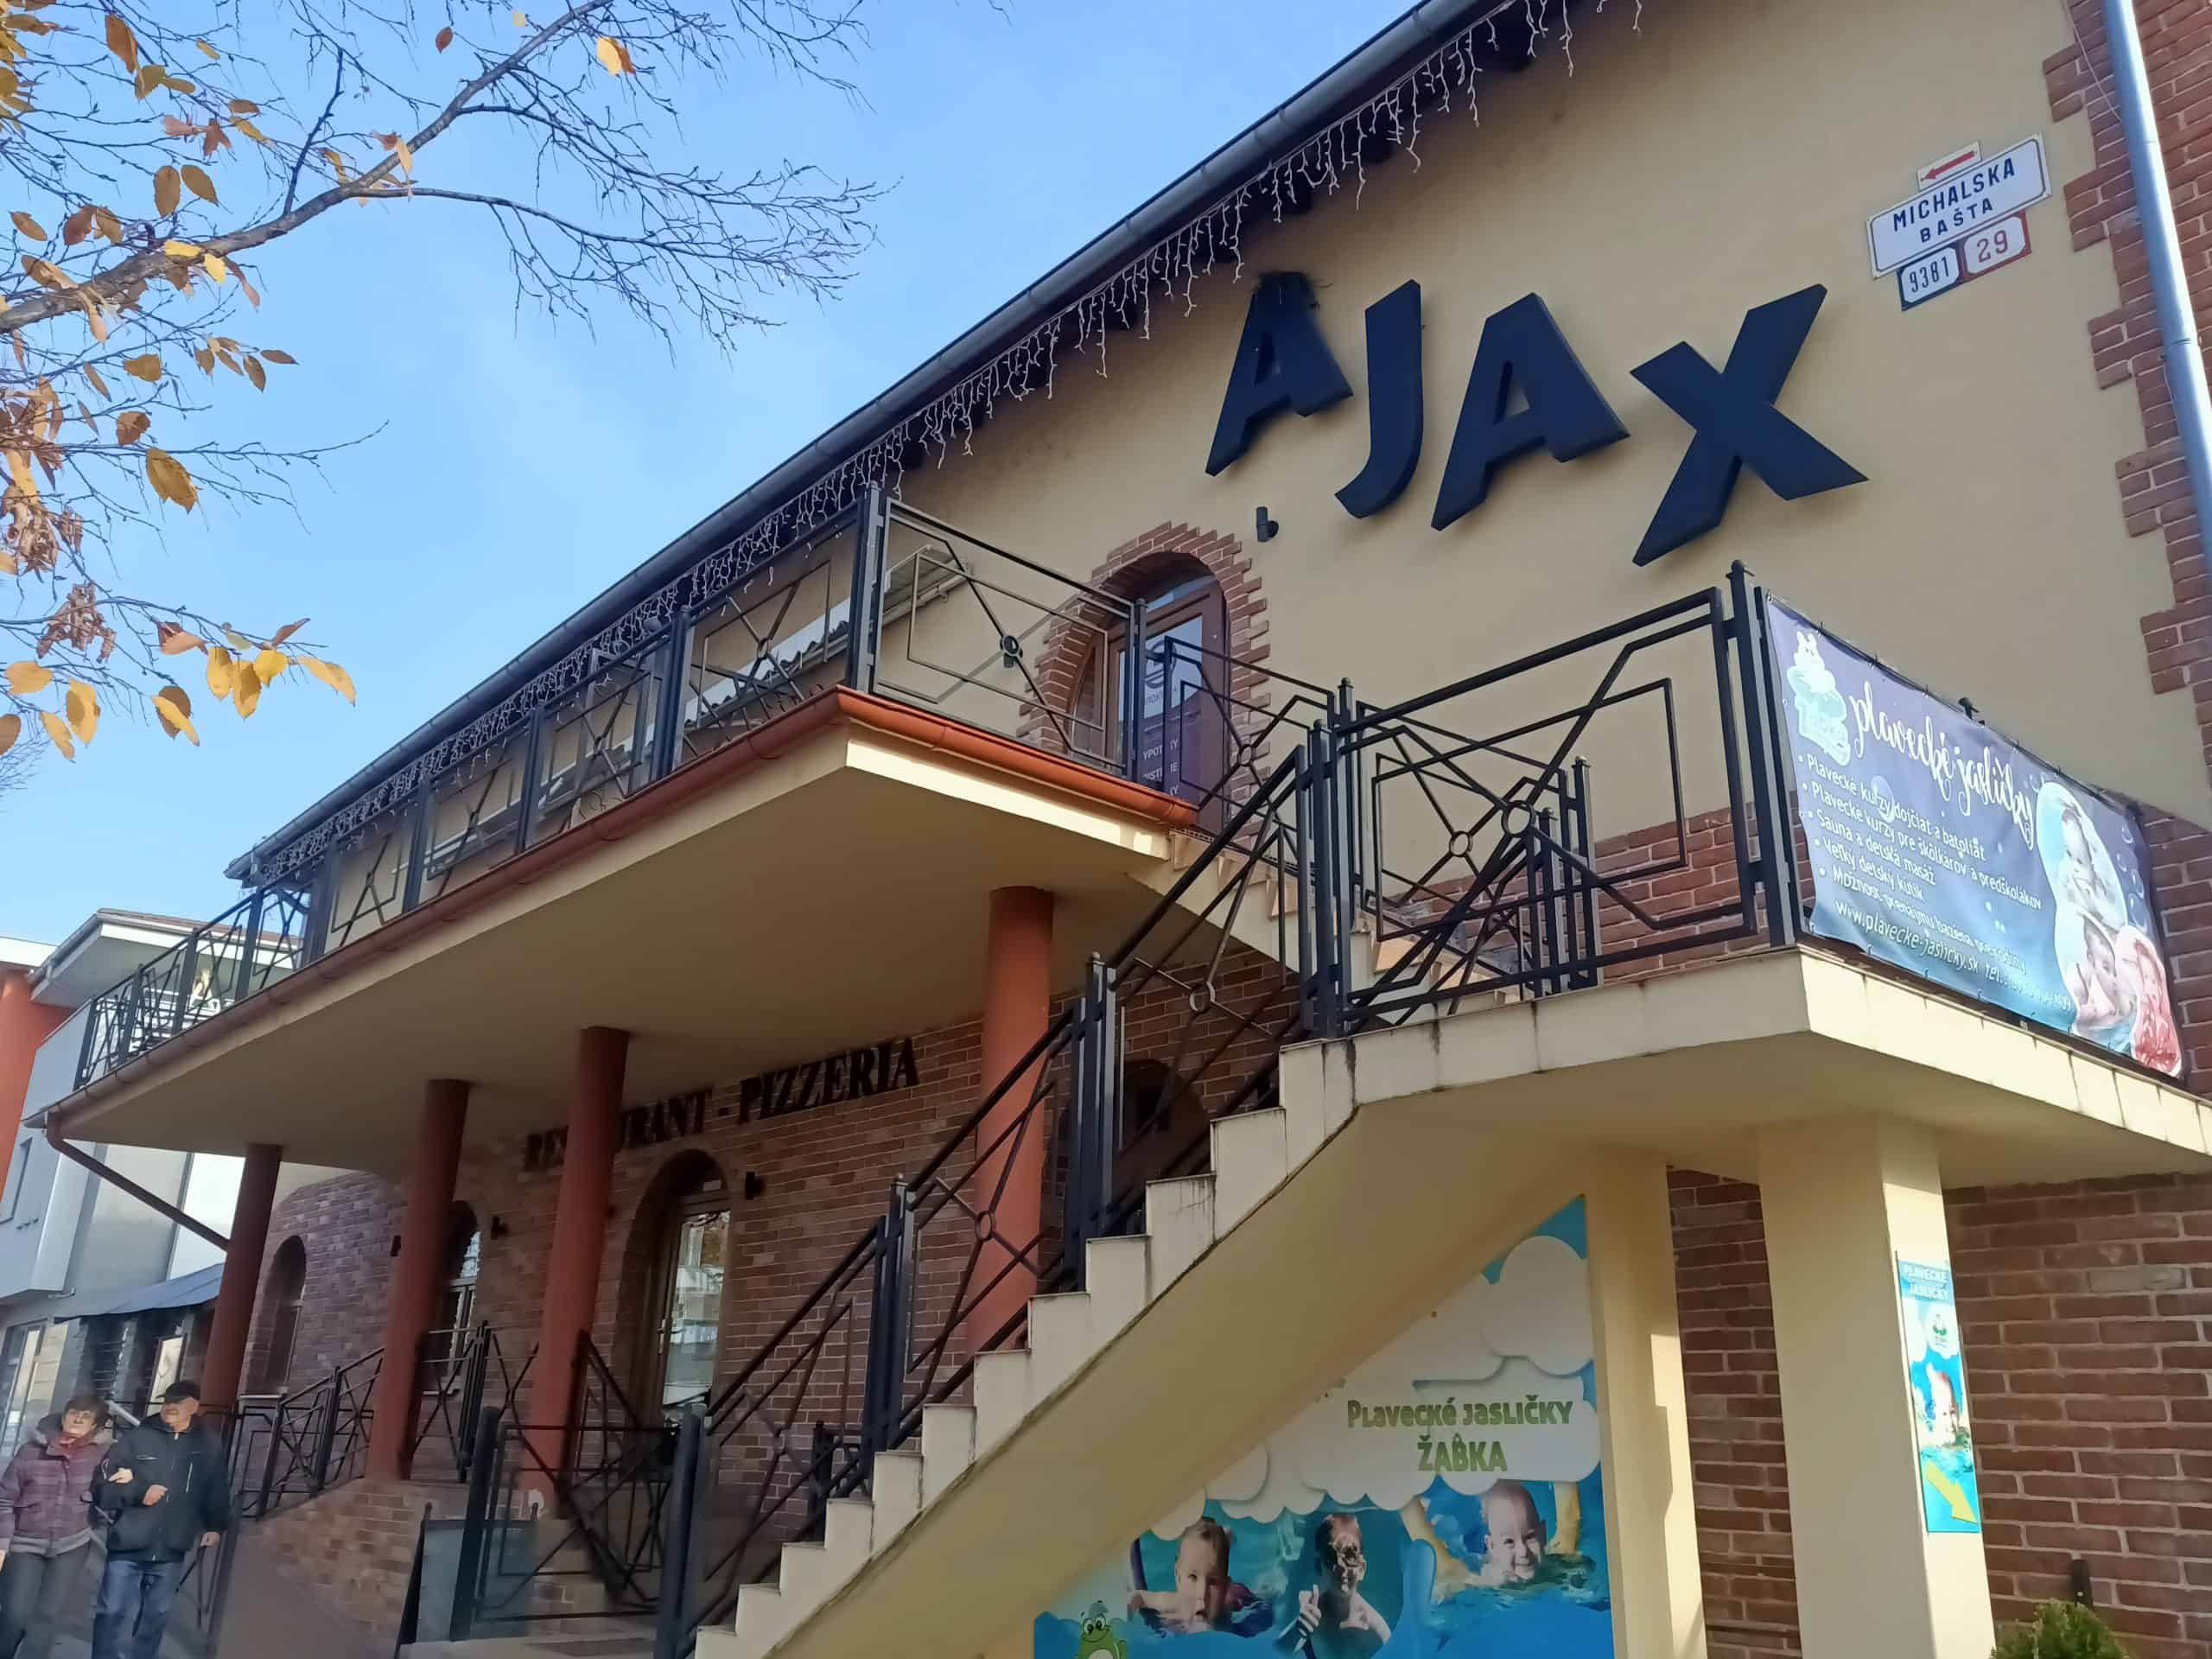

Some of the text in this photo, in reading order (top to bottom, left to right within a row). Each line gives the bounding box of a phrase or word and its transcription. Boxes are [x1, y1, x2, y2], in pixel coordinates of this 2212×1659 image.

[1893, 157, 2015, 232] MICHALSKA
[1920, 198, 1993, 243] BAŠTA
[1909, 256, 1950, 293] 9381
[1976, 229, 2009, 263] 29
[1205, 271, 1869, 567] AJAX
[1807, 753, 1858, 796] Plavecké
[1860, 781, 1891, 817] kurzy
[1892, 800, 1933, 836] dojčiat
[1935, 826, 1941, 839] a
[1811, 781, 1864, 823] Plavecké
[1864, 810, 1895, 843] kurzy
[1897, 830, 1916, 851] pre
[1970, 868, 1978, 880] a
[1816, 808, 1853, 842] Sauna
[1855, 832, 1863, 847] a
[1866, 836, 1901, 866] detská
[738, 1037, 919, 1124] PIZZERIA
[1417, 1433, 1508, 1472] ŽABKA
